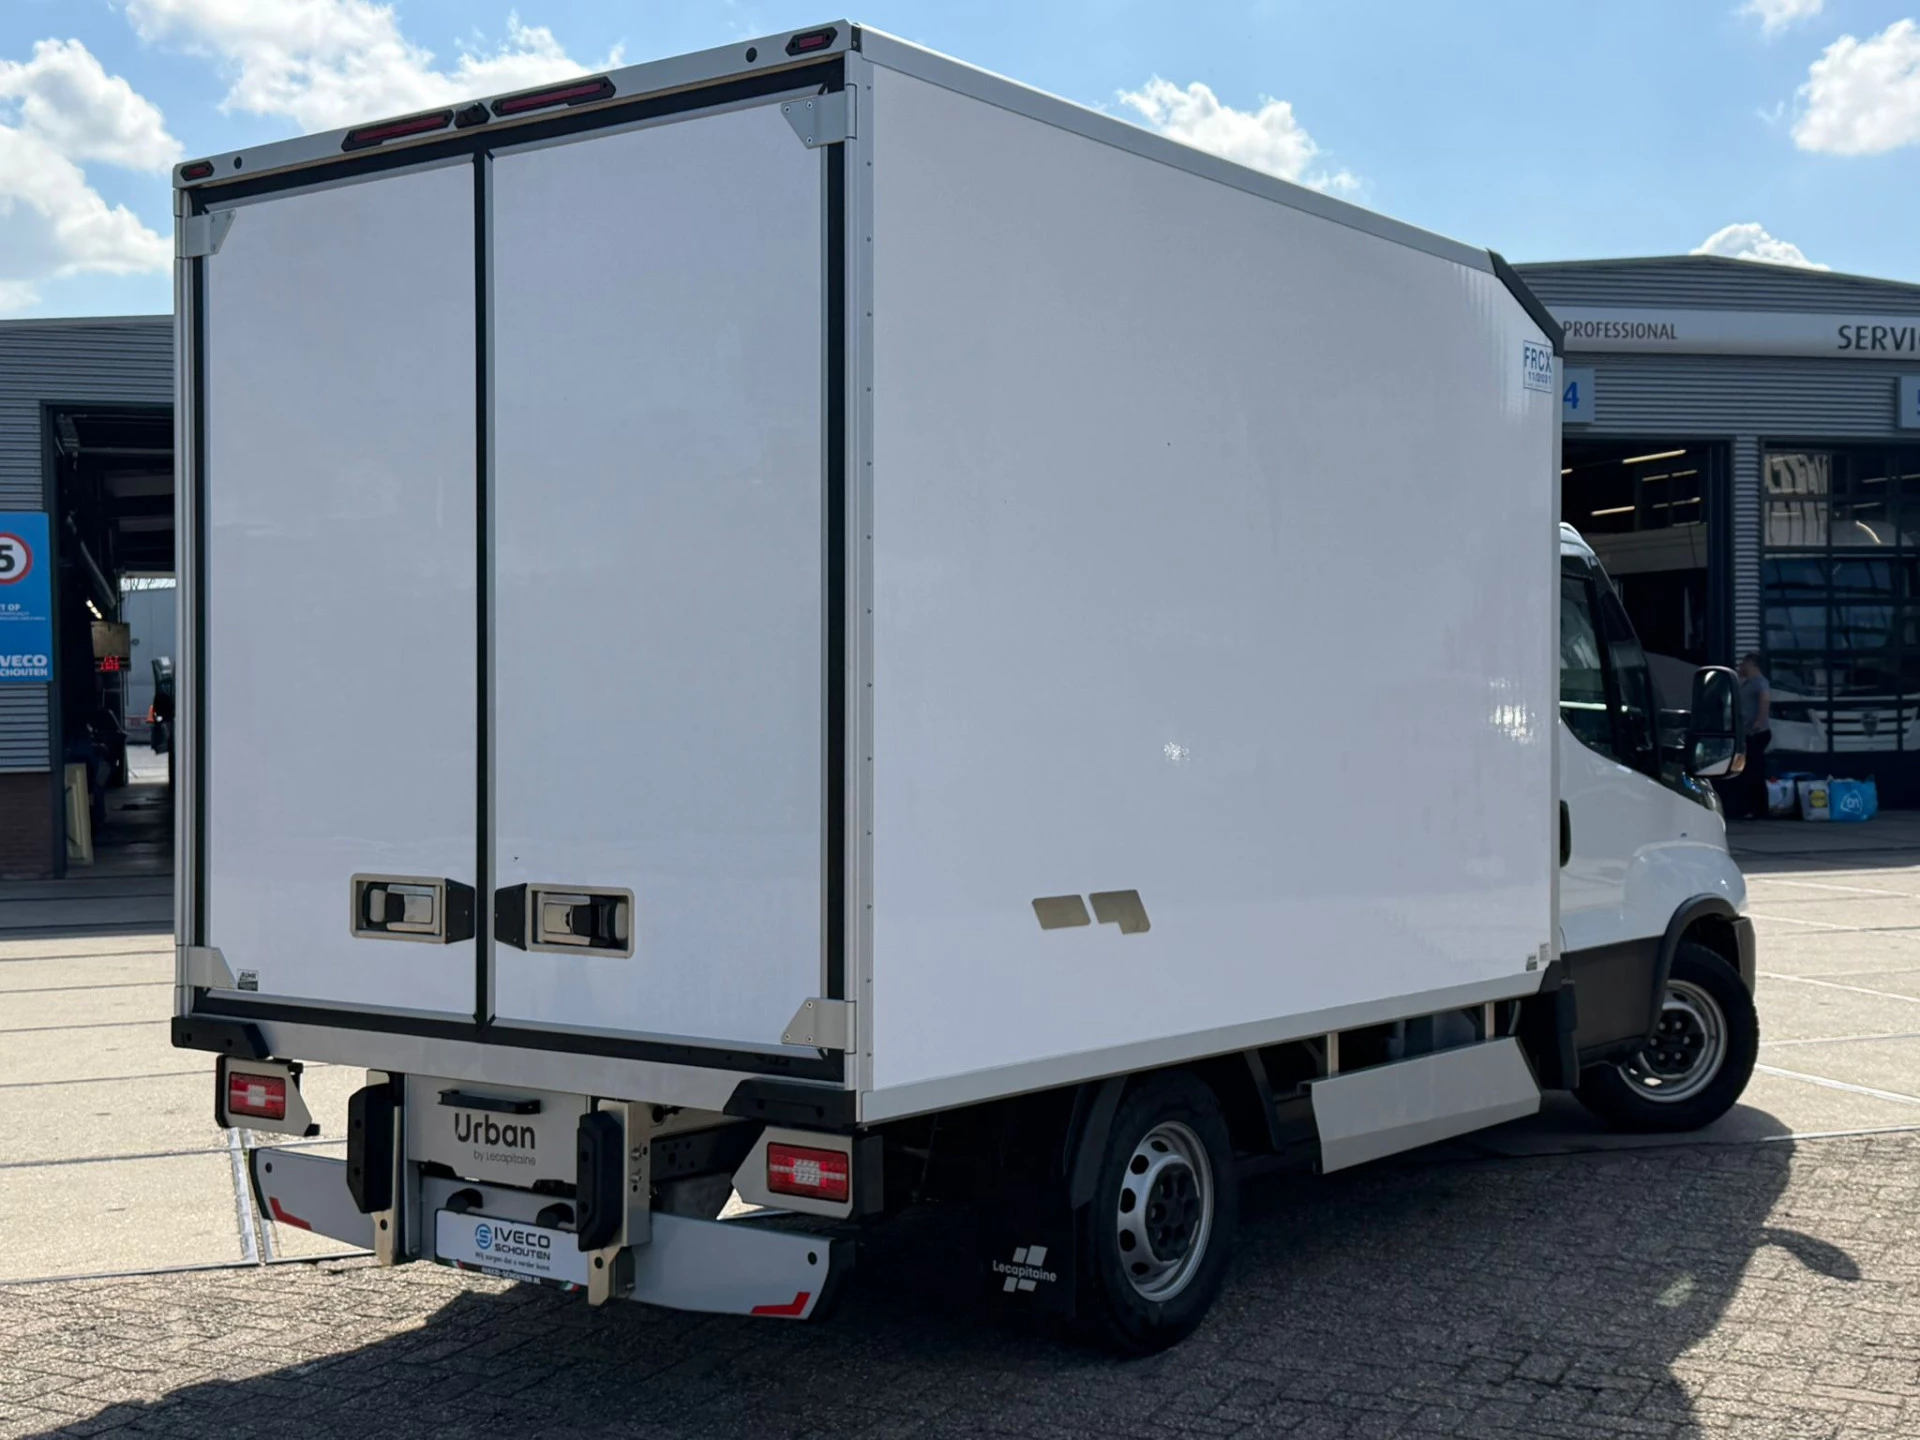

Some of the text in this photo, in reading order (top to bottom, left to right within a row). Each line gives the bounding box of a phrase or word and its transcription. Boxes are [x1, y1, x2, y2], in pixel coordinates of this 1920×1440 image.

[1563, 321, 1678, 340] PROFESSIONAL
[1837, 324, 1920, 351] SERVI
[1524, 346, 1552, 373] FRCX
[1563, 381, 1580, 409] 4
[455, 1112, 536, 1150] Urban
[474, 1149, 484, 1163] by
[495, 1226, 551, 1249] IVECO
[495, 1243, 551, 1261] SCHOUTEN
[992, 1259, 1057, 1282] Lecapitaine
